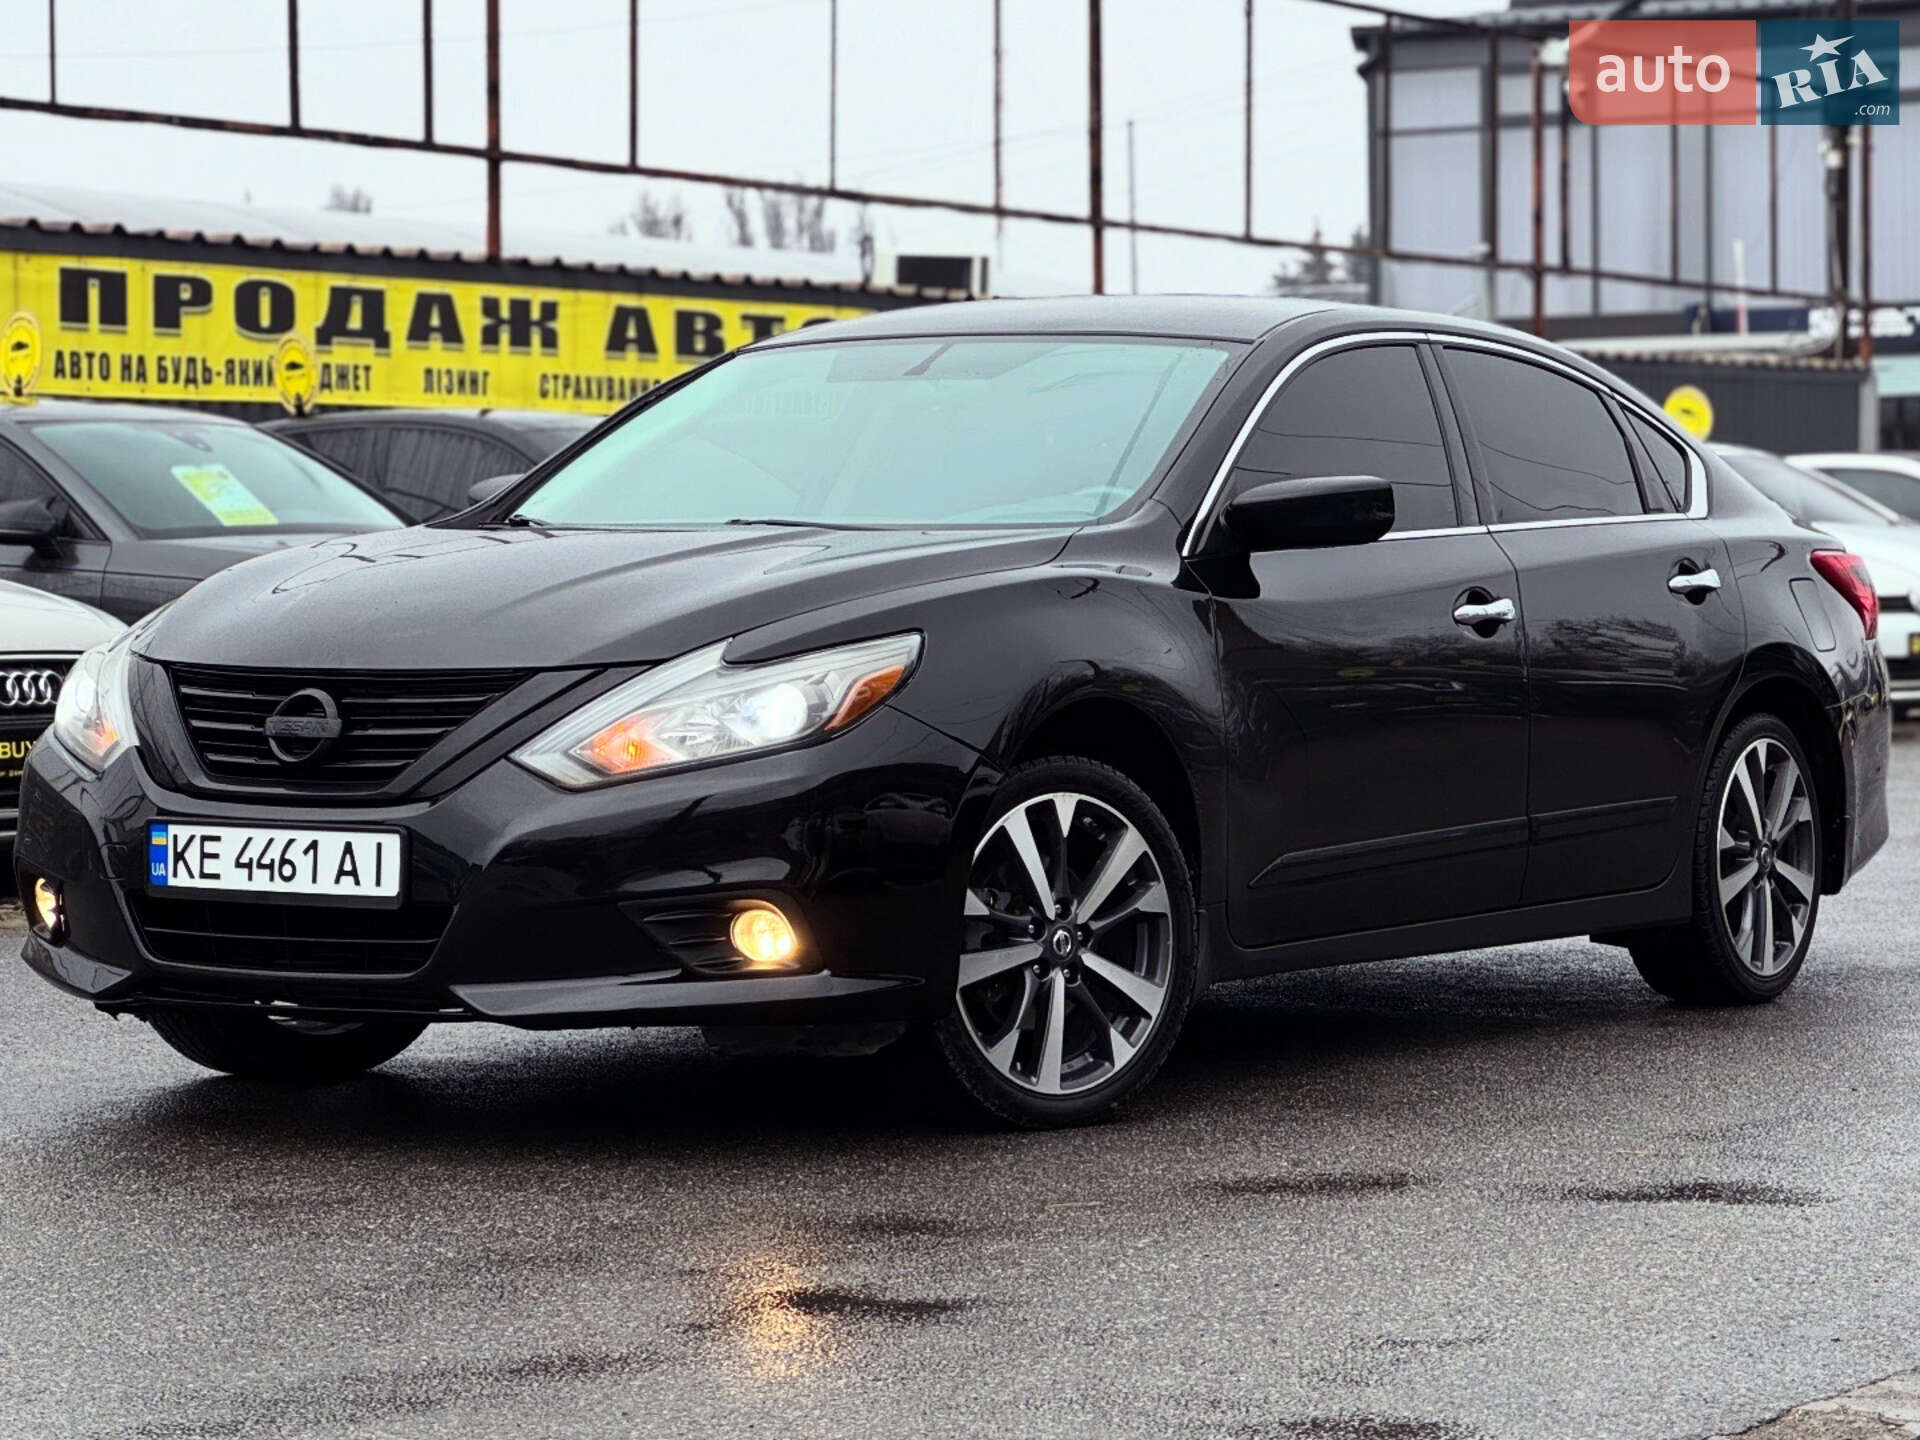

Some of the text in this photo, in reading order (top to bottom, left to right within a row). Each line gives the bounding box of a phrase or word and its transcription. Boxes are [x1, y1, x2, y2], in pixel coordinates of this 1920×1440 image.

[59, 267, 832, 360] ПРОДАЖ АВТ
[53, 350, 111, 382] АВТО
[120, 354, 148, 384] НА
[319, 363, 372, 393] ДЖЕТ
[423, 367, 490, 396] ЛІЗИНГ
[539, 372, 662, 402] СТРАХУВАНН
[151, 862, 167, 877] UA
[172, 833, 383, 887] KE 4461 AI
